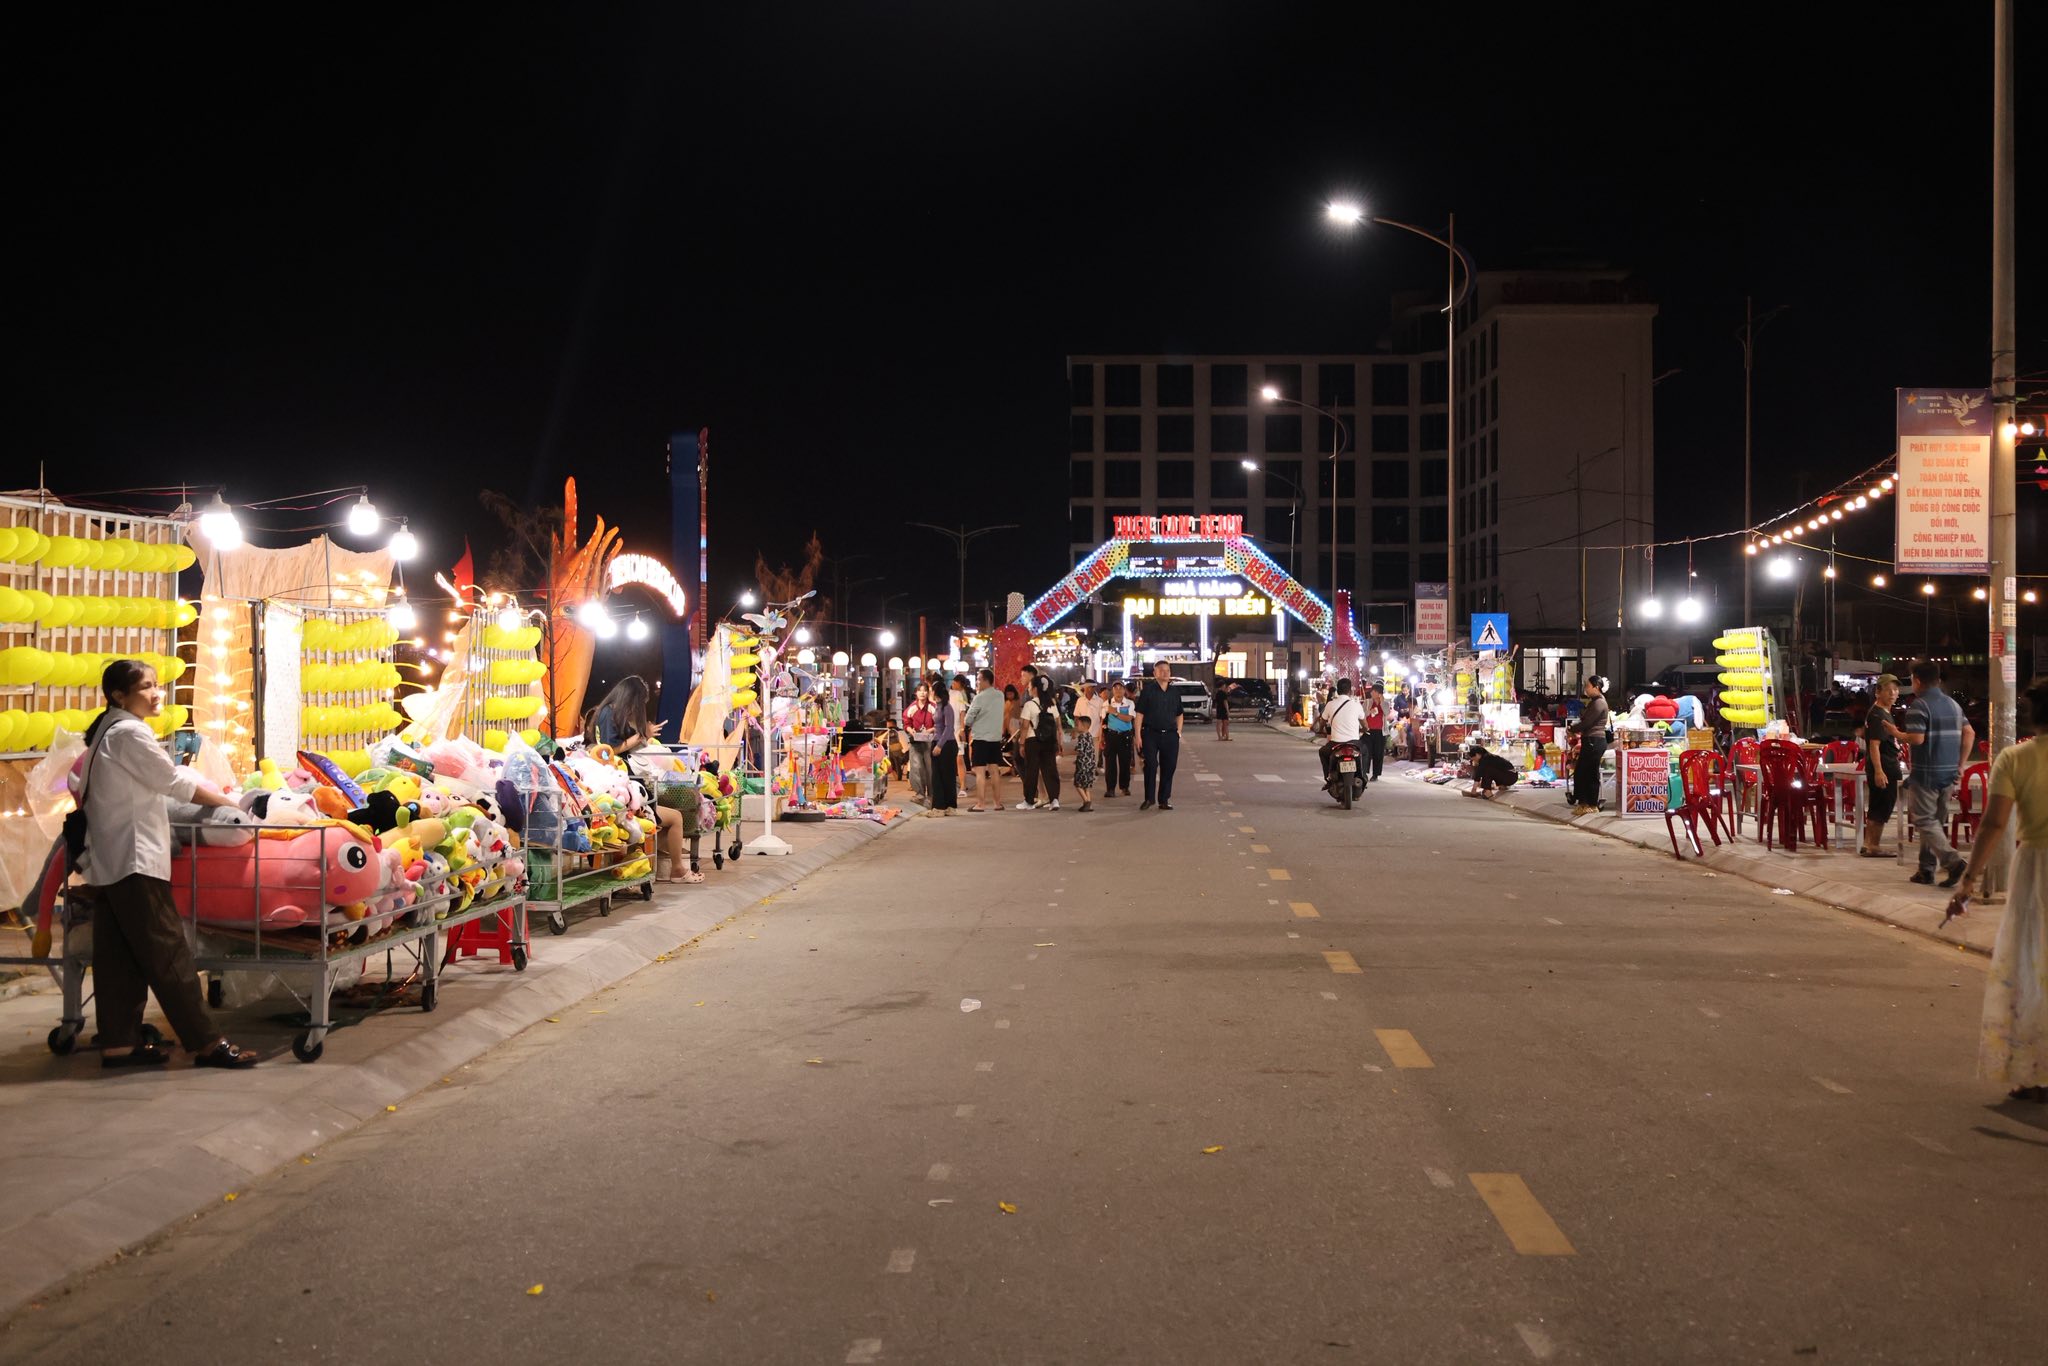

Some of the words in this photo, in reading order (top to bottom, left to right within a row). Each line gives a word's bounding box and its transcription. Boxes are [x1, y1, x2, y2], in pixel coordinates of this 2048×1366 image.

[1075, 559, 1111, 593] CLUB
[1243, 557, 1289, 597] BEACH
[1225, 590, 1265, 616] BIỂN
[1630, 756, 1644, 770] LẠP
